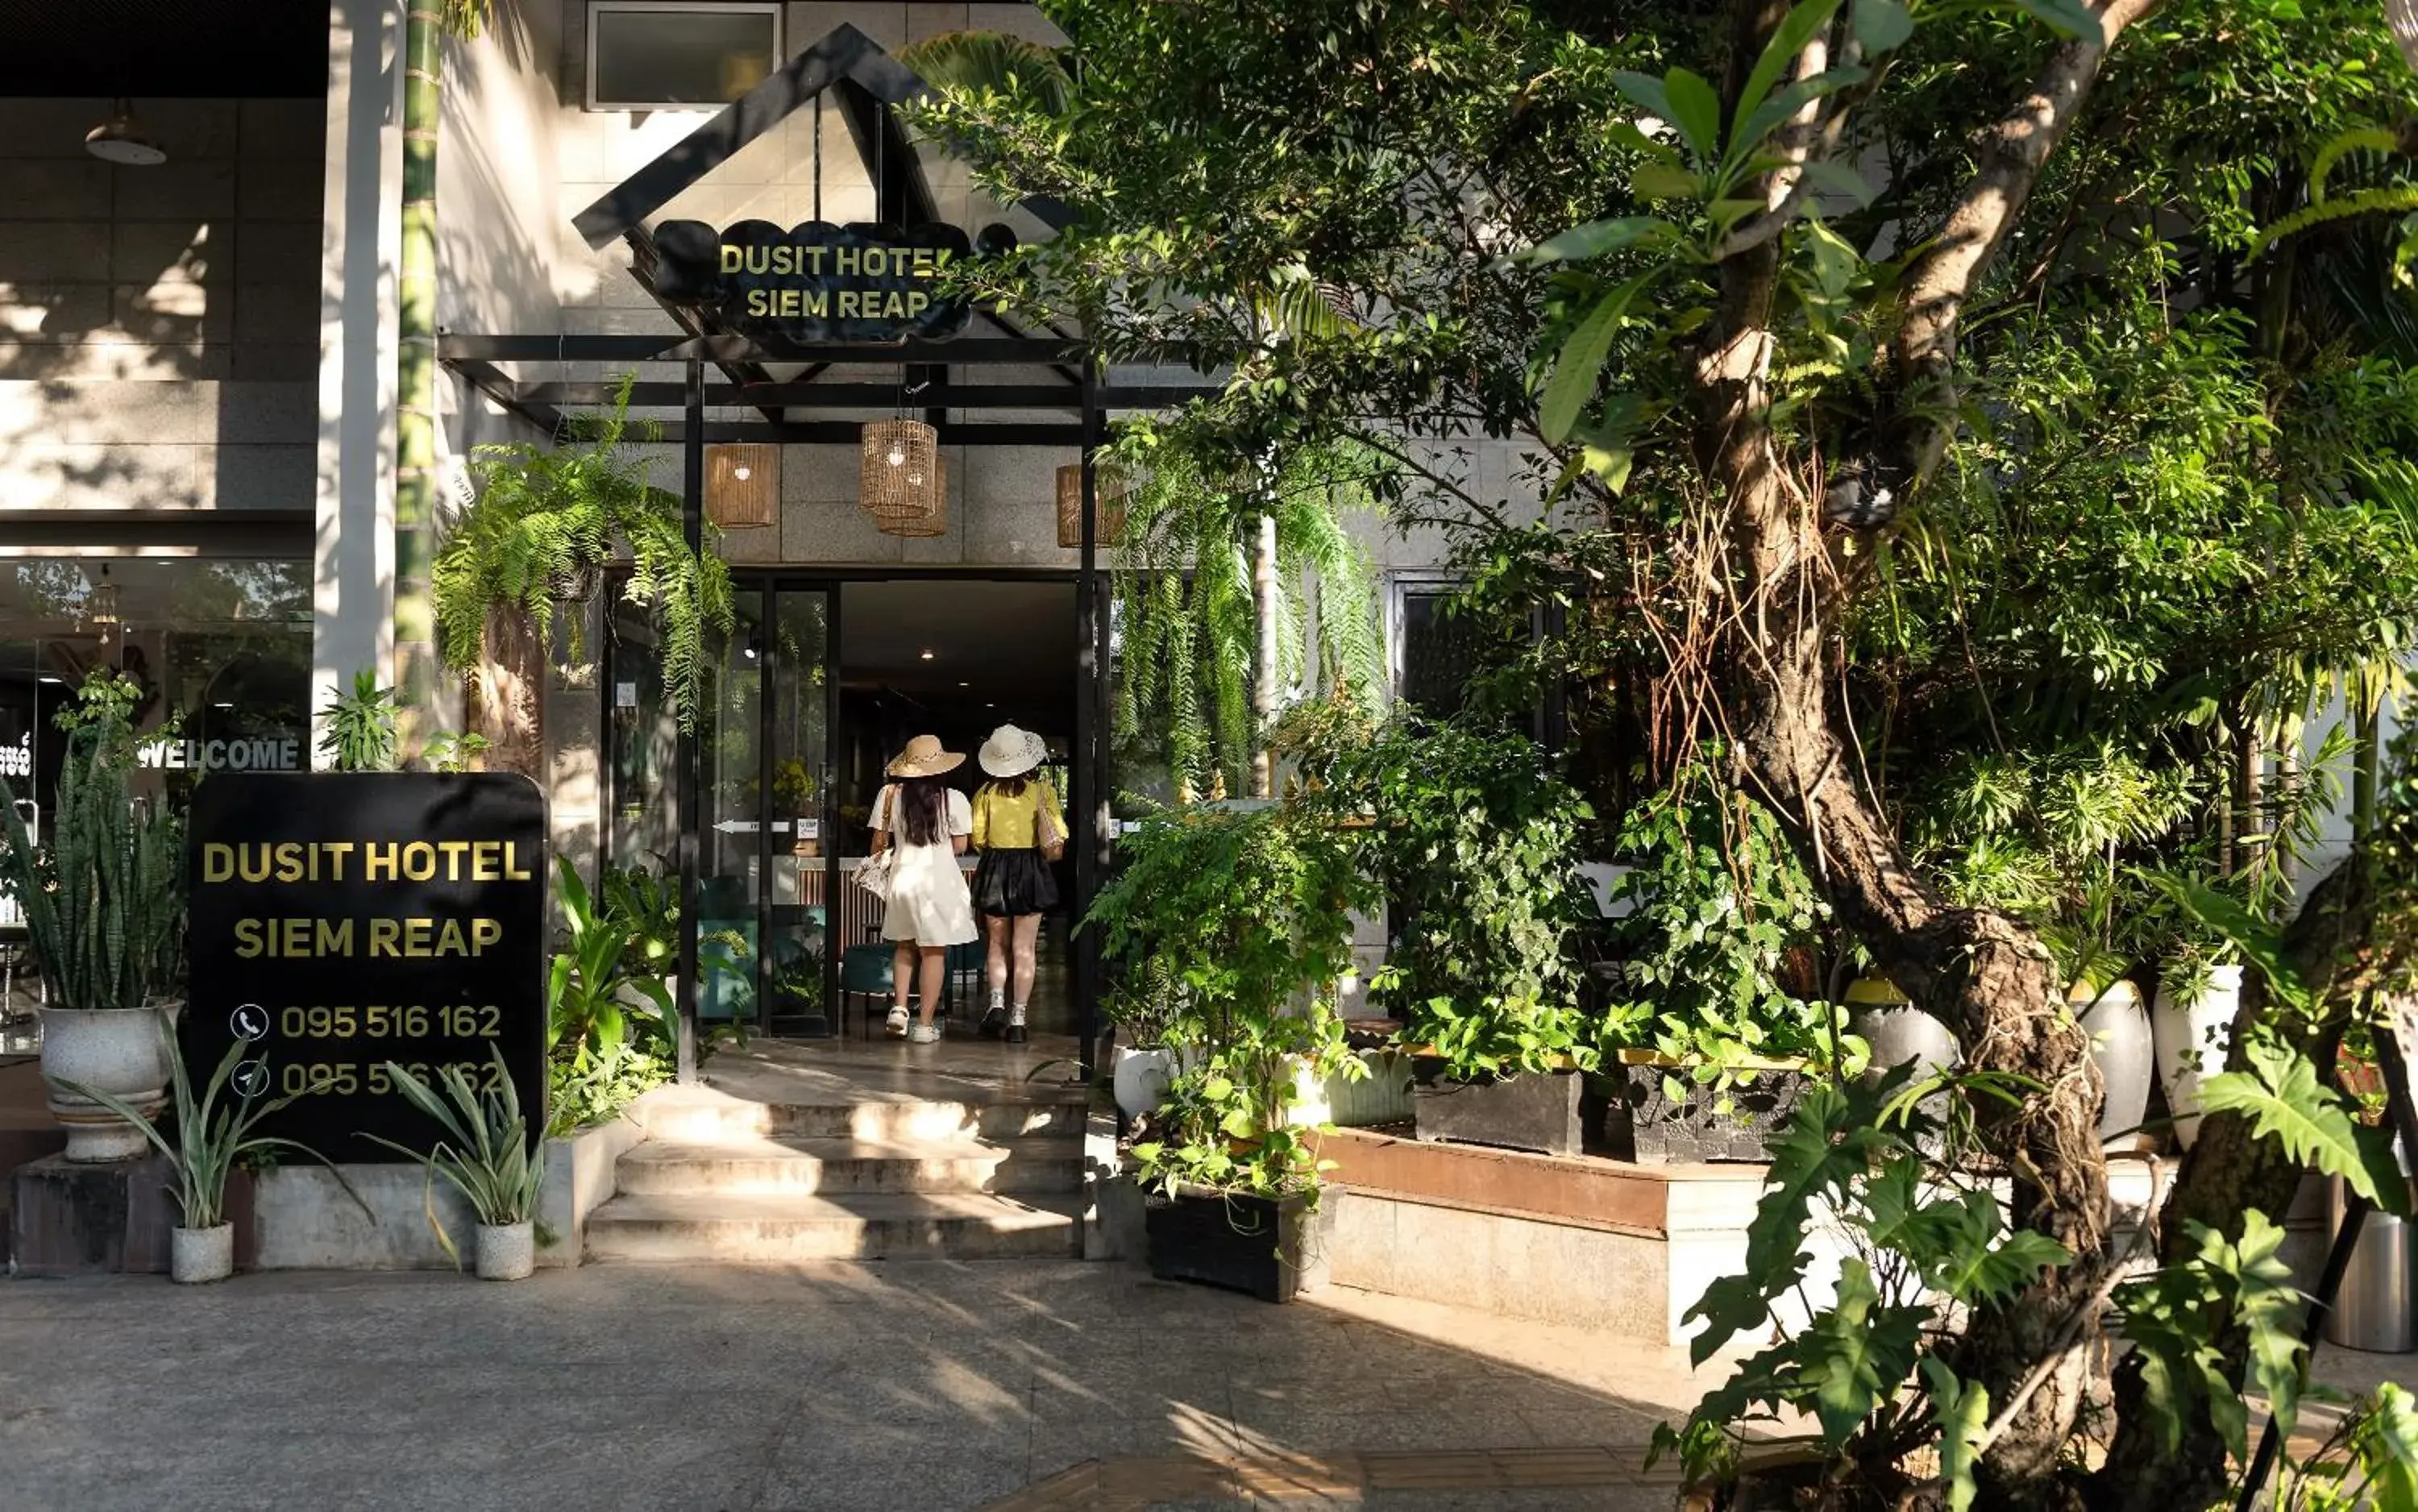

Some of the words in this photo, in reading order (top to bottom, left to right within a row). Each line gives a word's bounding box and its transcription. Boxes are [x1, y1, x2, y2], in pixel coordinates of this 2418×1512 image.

[721, 245, 828, 275] DUSIT
[747, 289, 828, 318] SIEM
[838, 290, 929, 318] REAP
[136, 739, 299, 770] WELCOME
[203, 841, 354, 883] DUSIT
[365, 841, 531, 882] HOTEL
[234, 918, 353, 958] SIEM
[369, 918, 502, 957] REAP
[282, 1006, 358, 1037] 095
[365, 1006, 430, 1037] 516
[438, 1006, 501, 1036] 162
[282, 1062, 358, 1095] 095
[367, 1062, 430, 1095] 56
